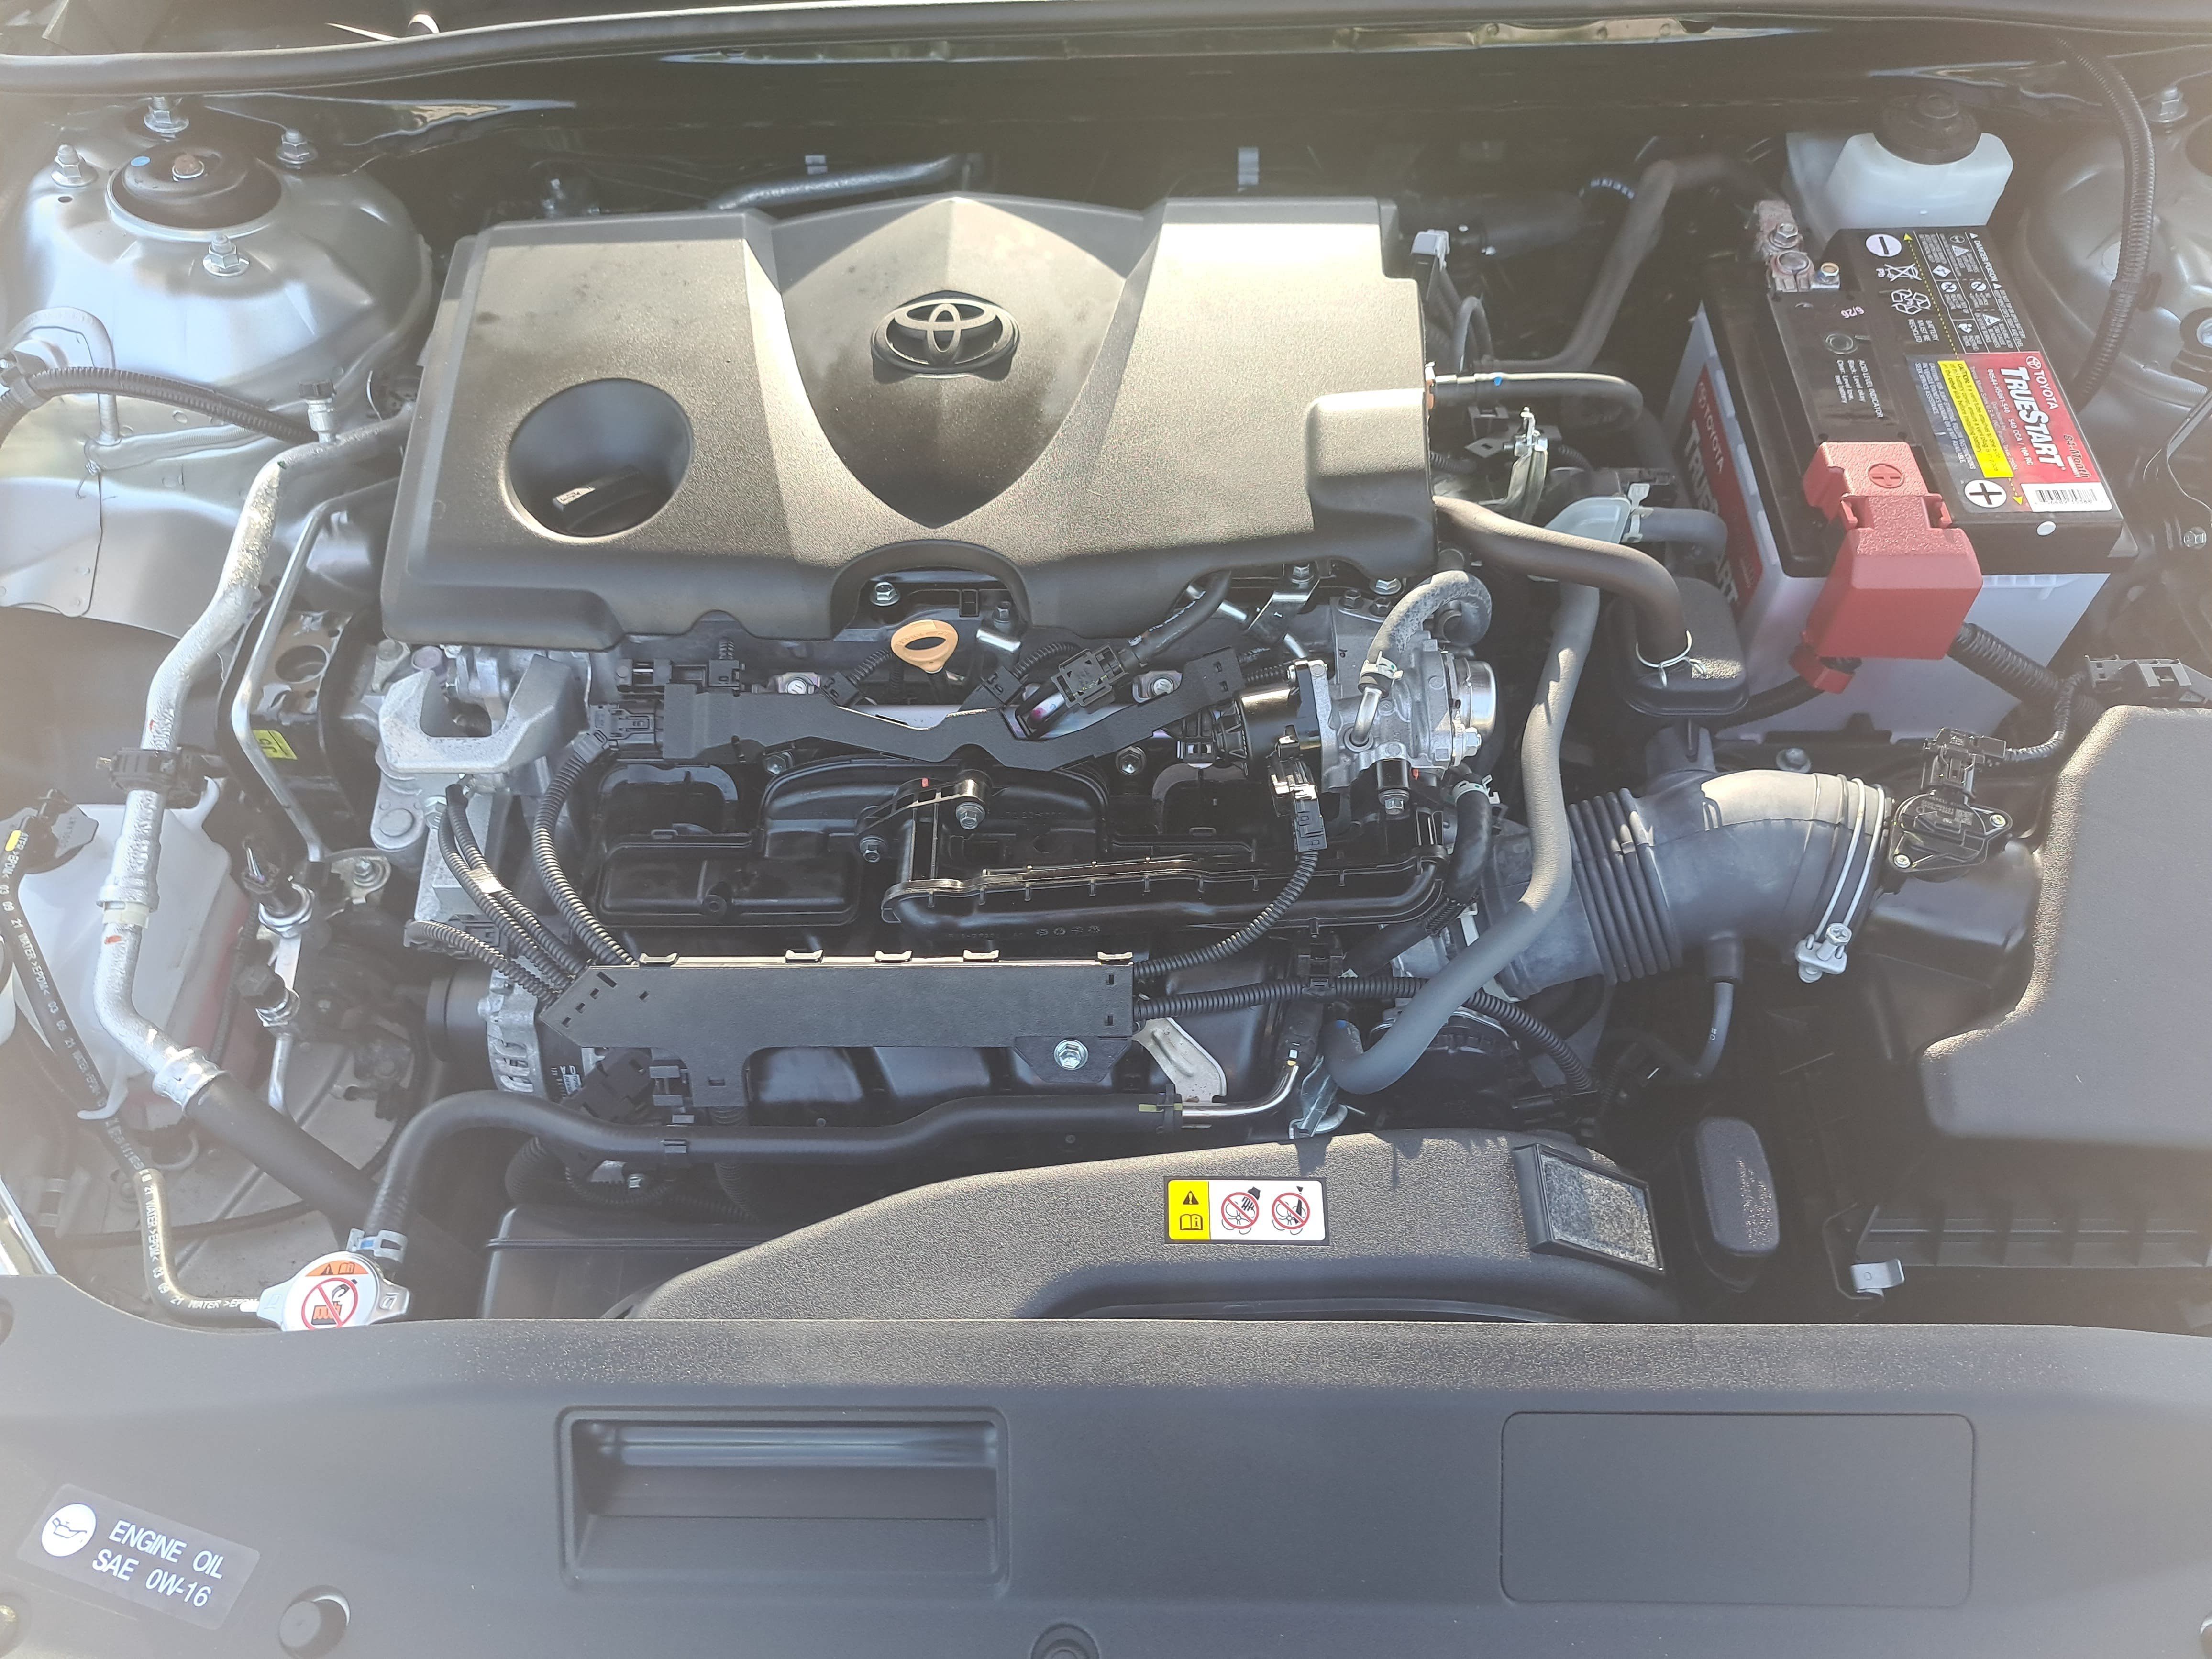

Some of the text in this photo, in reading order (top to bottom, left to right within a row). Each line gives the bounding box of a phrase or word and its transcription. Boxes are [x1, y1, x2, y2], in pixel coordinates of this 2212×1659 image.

[1907, 319, 1923, 342] RECYCLED
[1915, 320, 1931, 341] MUST BE
[1924, 320, 1940, 341] BATTERY
[2032, 370, 2061, 409] TOYOTA
[2007, 418, 2018, 429] 540
[1703, 406, 1725, 474] TOYOTA
[2012, 430, 2024, 441] CCA
[2019, 447, 2030, 456] 100
[1684, 420, 1739, 605] TRUEART
[11, 918, 23, 929] 21
[18, 932, 36, 960] WATER
[188, 1299, 222, 1309] WATER
[108, 1519, 224, 1579] ENGINE OIL
[92, 1548, 212, 1608] SAE 0W-16
